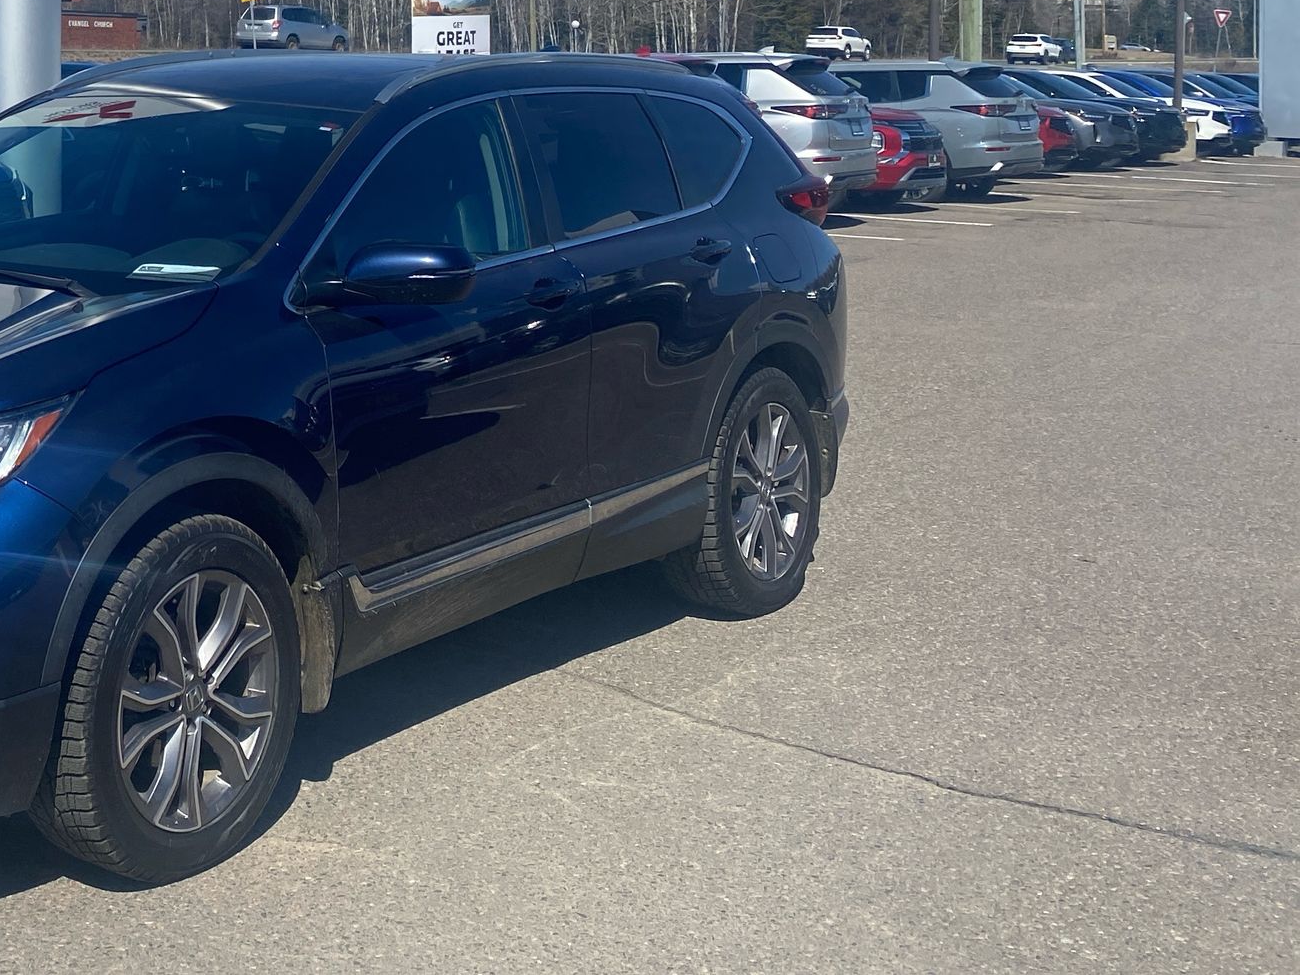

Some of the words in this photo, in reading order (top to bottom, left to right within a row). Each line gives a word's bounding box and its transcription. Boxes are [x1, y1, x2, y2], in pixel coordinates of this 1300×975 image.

[93, 20, 113, 28] CHURCH
[452, 21, 463, 29] GET
[437, 30, 476, 46] GREAT
